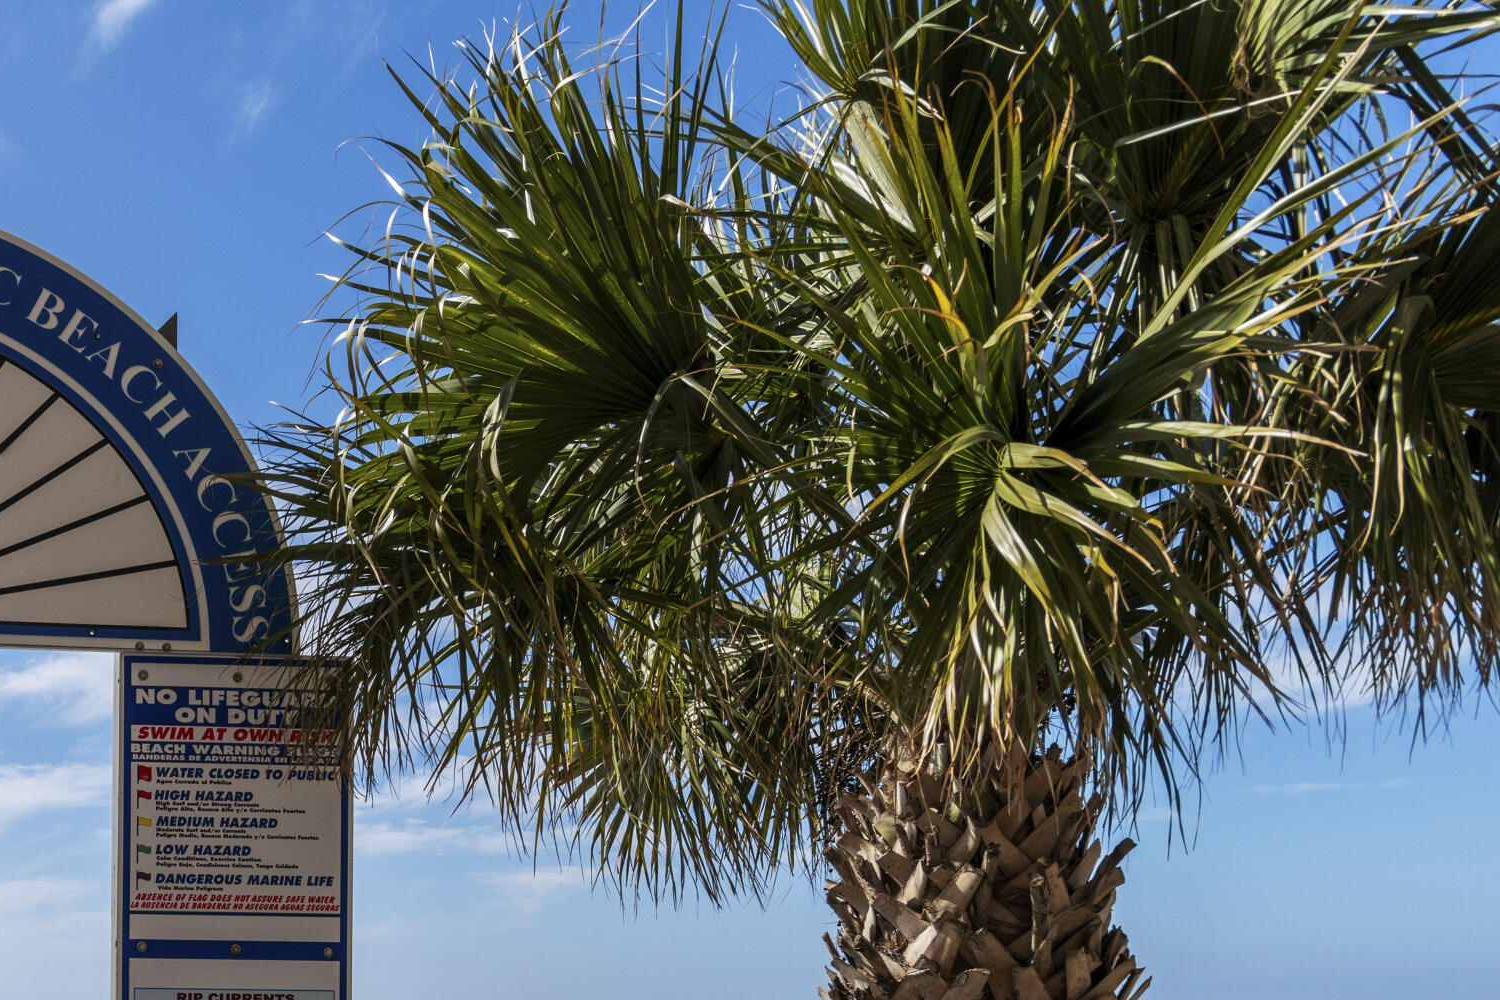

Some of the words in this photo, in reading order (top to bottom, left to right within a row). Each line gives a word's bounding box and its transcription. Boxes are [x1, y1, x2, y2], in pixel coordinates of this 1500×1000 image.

[28, 287, 190, 438] BEACH
[172, 447, 269, 643] ACCESS
[136, 688, 177, 705] NO
[175, 707, 216, 724] ON
[228, 710, 300, 725] DUTY
[138, 726, 194, 740] SWIM
[202, 728, 227, 741] AT
[233, 728, 282, 742] OWN
[131, 744, 185, 754] BEACH
[192, 744, 279, 755] WARNING
[156, 767, 203, 778] WATER
[208, 768, 260, 779] CLOSED
[265, 769, 283, 779] TO
[154, 790, 190, 800] HIGH
[194, 791, 253, 801] HAZARD
[156, 816, 214, 827] MEDIUM
[219, 817, 278, 828] HAZARD
[155, 845, 188, 855] LOW
[192, 845, 251, 855] HAZARD
[155, 874, 242, 885] DANGEROUS
[246, 876, 301, 886] MARINE
[306, 876, 333, 886] LIFE
[188, 894, 207, 902] FLAG
[251, 895, 283, 903] ASSURE
[307, 896, 335, 904] WATER
[191, 902, 230, 910] BANDERAS
[244, 903, 278, 911] ASEGURA
